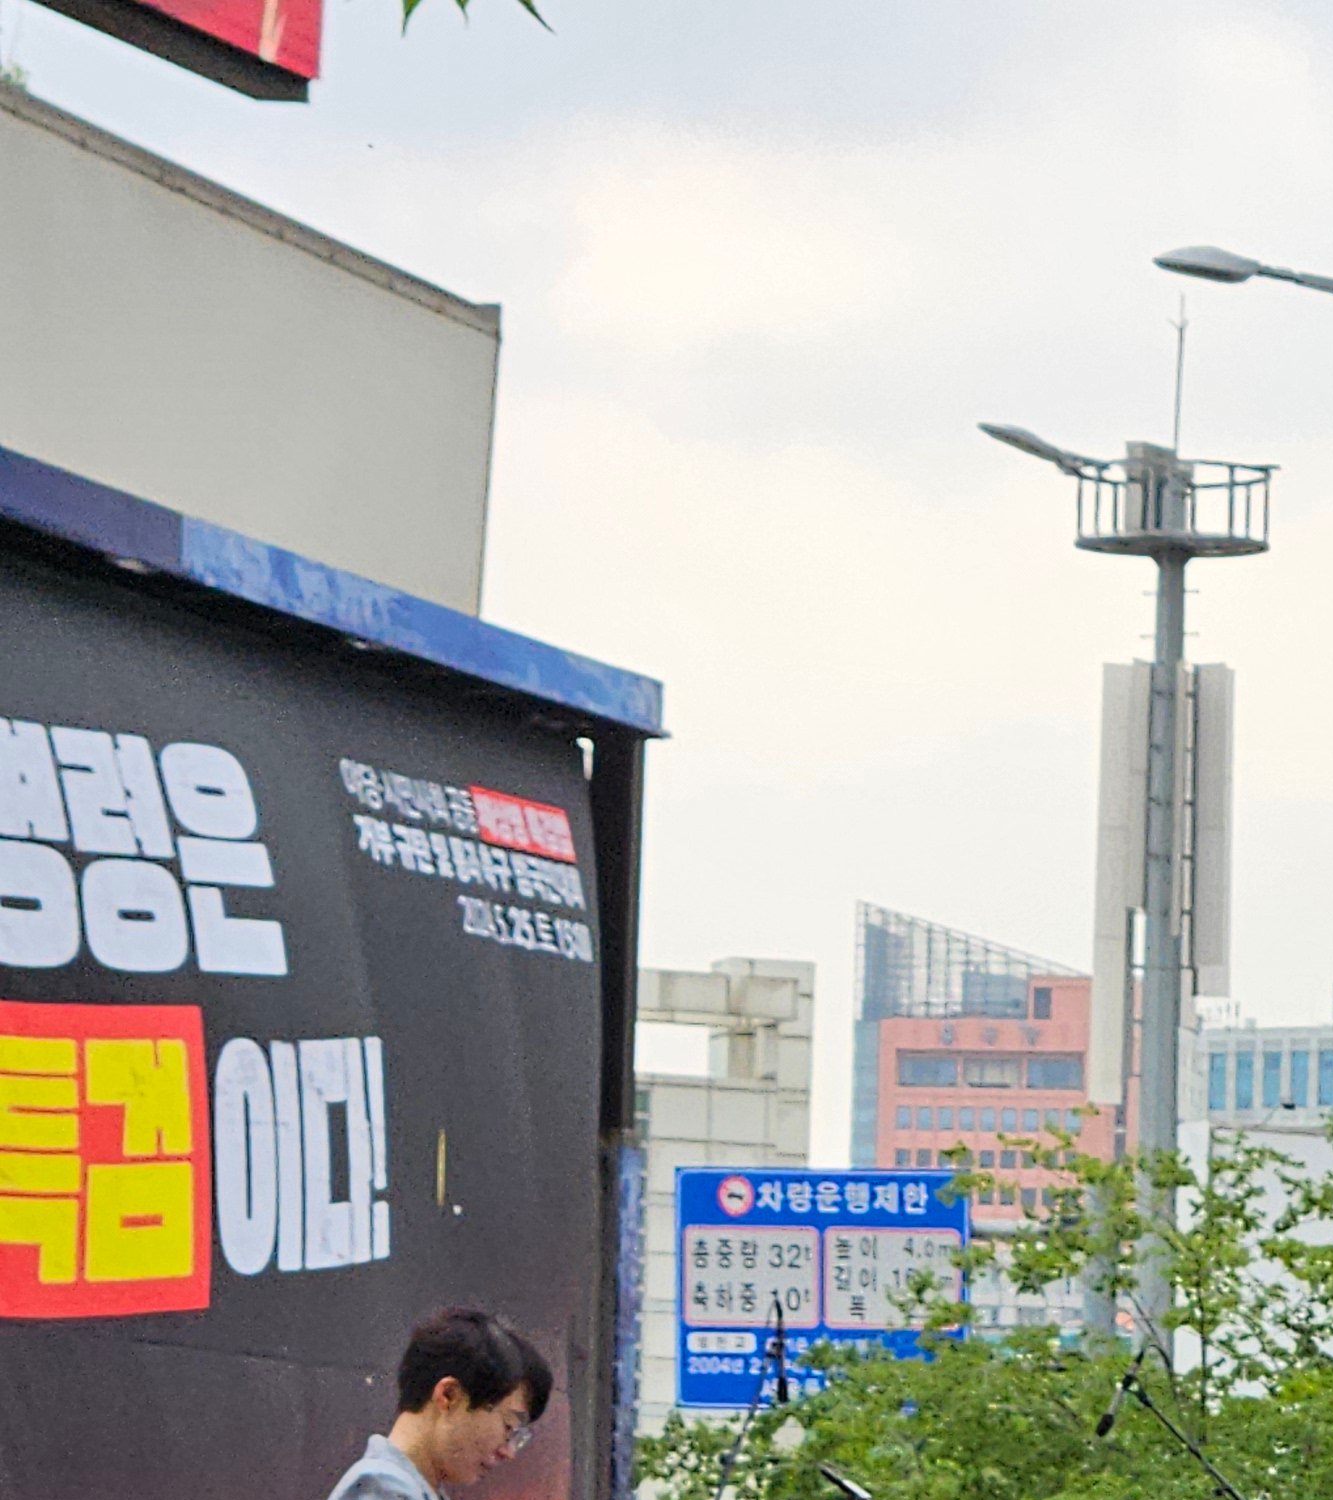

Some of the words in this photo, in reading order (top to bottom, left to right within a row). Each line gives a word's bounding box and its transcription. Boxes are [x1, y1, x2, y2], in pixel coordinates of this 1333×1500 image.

[757, 1181, 928, 1214] 차량운행제한
[692, 1239, 758, 1269] 총중량
[835, 1236, 878, 1260] 높이
[834, 1265, 877, 1291] 길이
